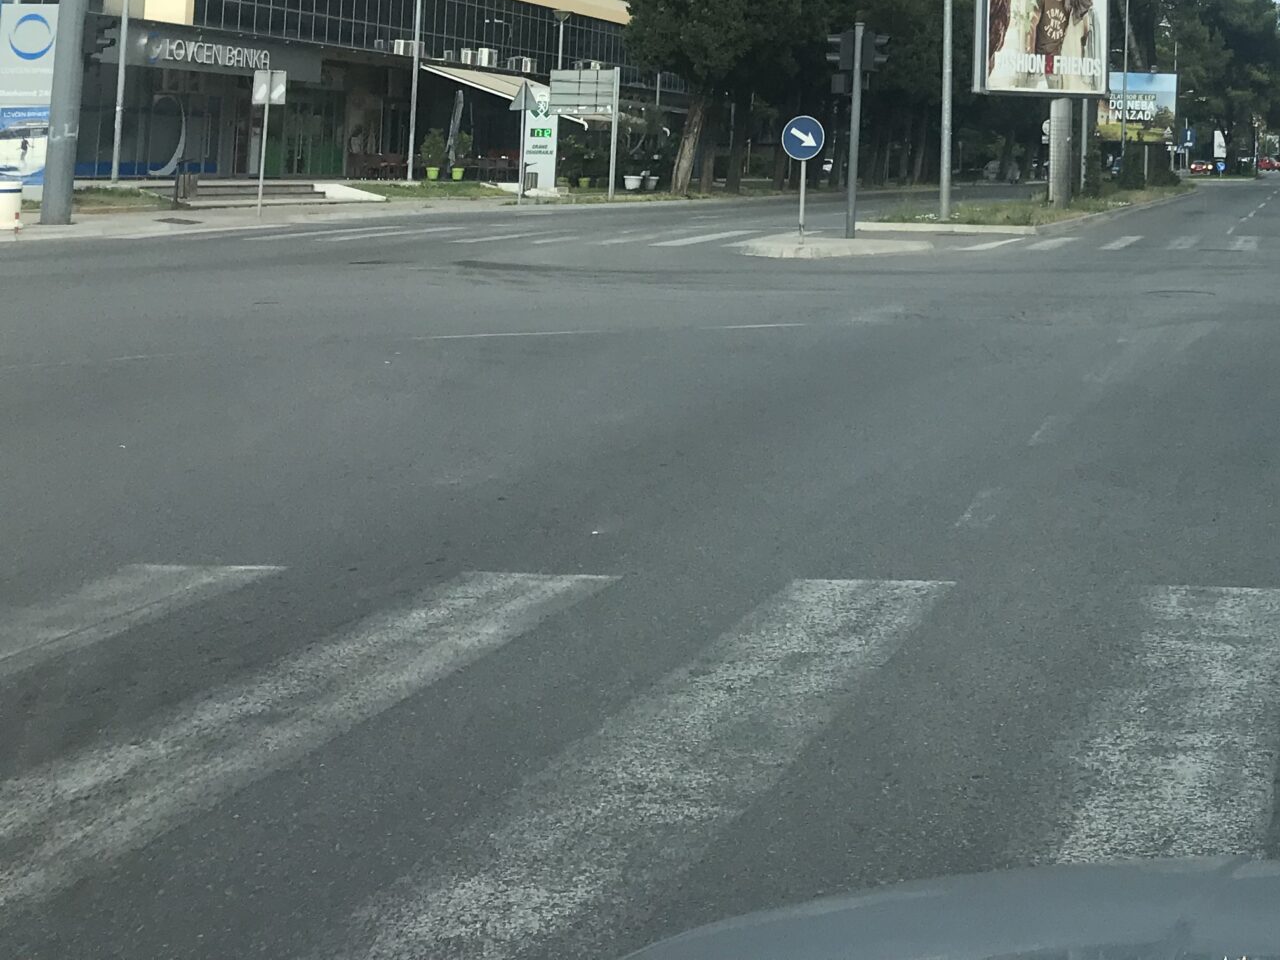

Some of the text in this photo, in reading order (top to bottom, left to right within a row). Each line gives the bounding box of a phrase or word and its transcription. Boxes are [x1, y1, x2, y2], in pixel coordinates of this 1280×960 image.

[225, 46, 270, 70] BANKA
[1053, 55, 1102, 76] FRIENDS
[1109, 100, 1154, 110] DO NEBA
